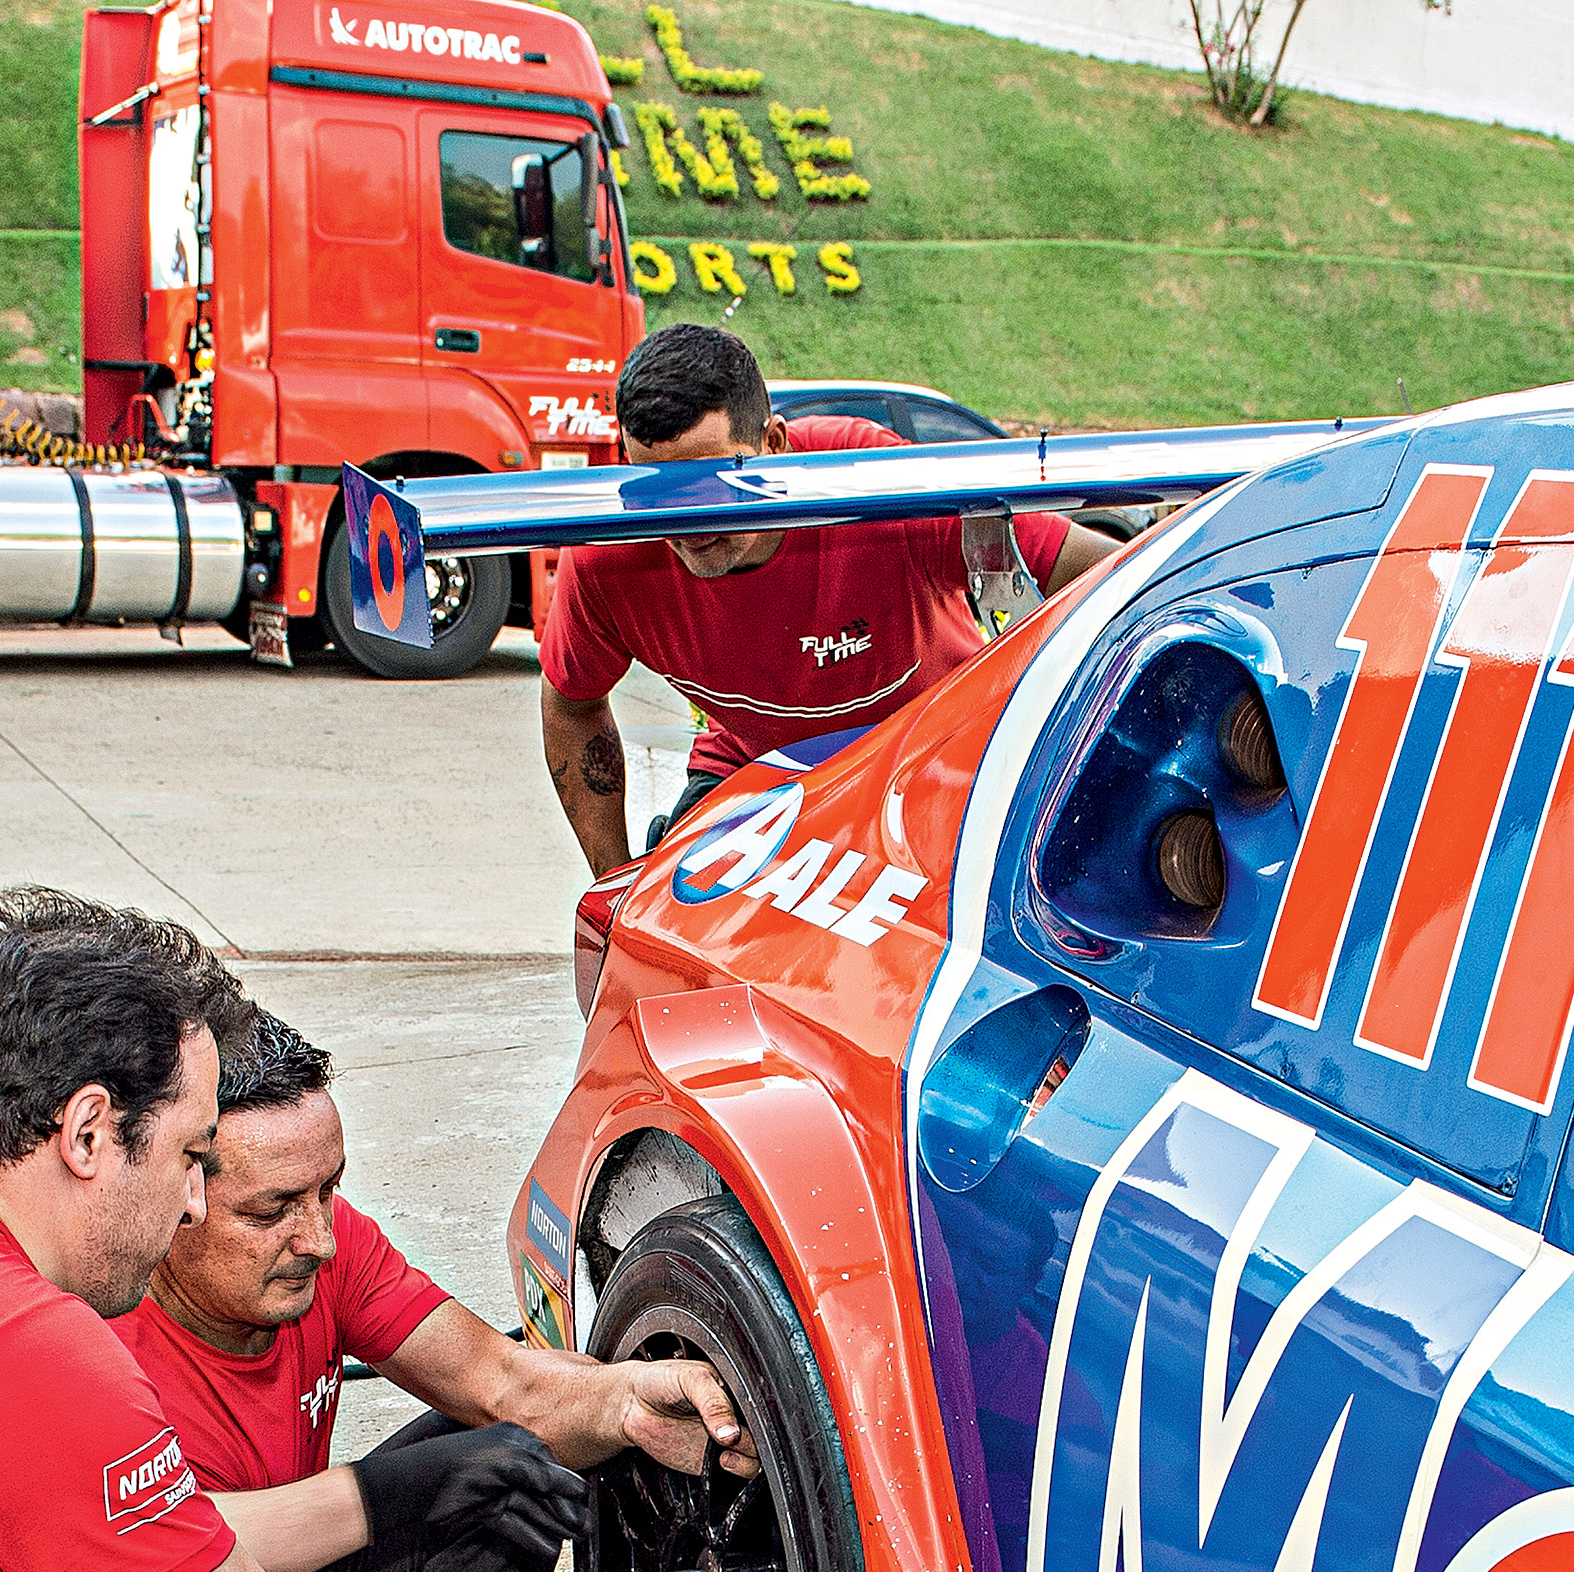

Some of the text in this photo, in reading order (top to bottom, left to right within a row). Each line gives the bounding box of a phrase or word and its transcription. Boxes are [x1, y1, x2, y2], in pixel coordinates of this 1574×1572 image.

[364, 19, 522, 65] AUTOTRAC
[799, 631, 857, 653] FULL
[742, 839, 929, 948] ALE
[530, 1200, 567, 1259] NORTON
